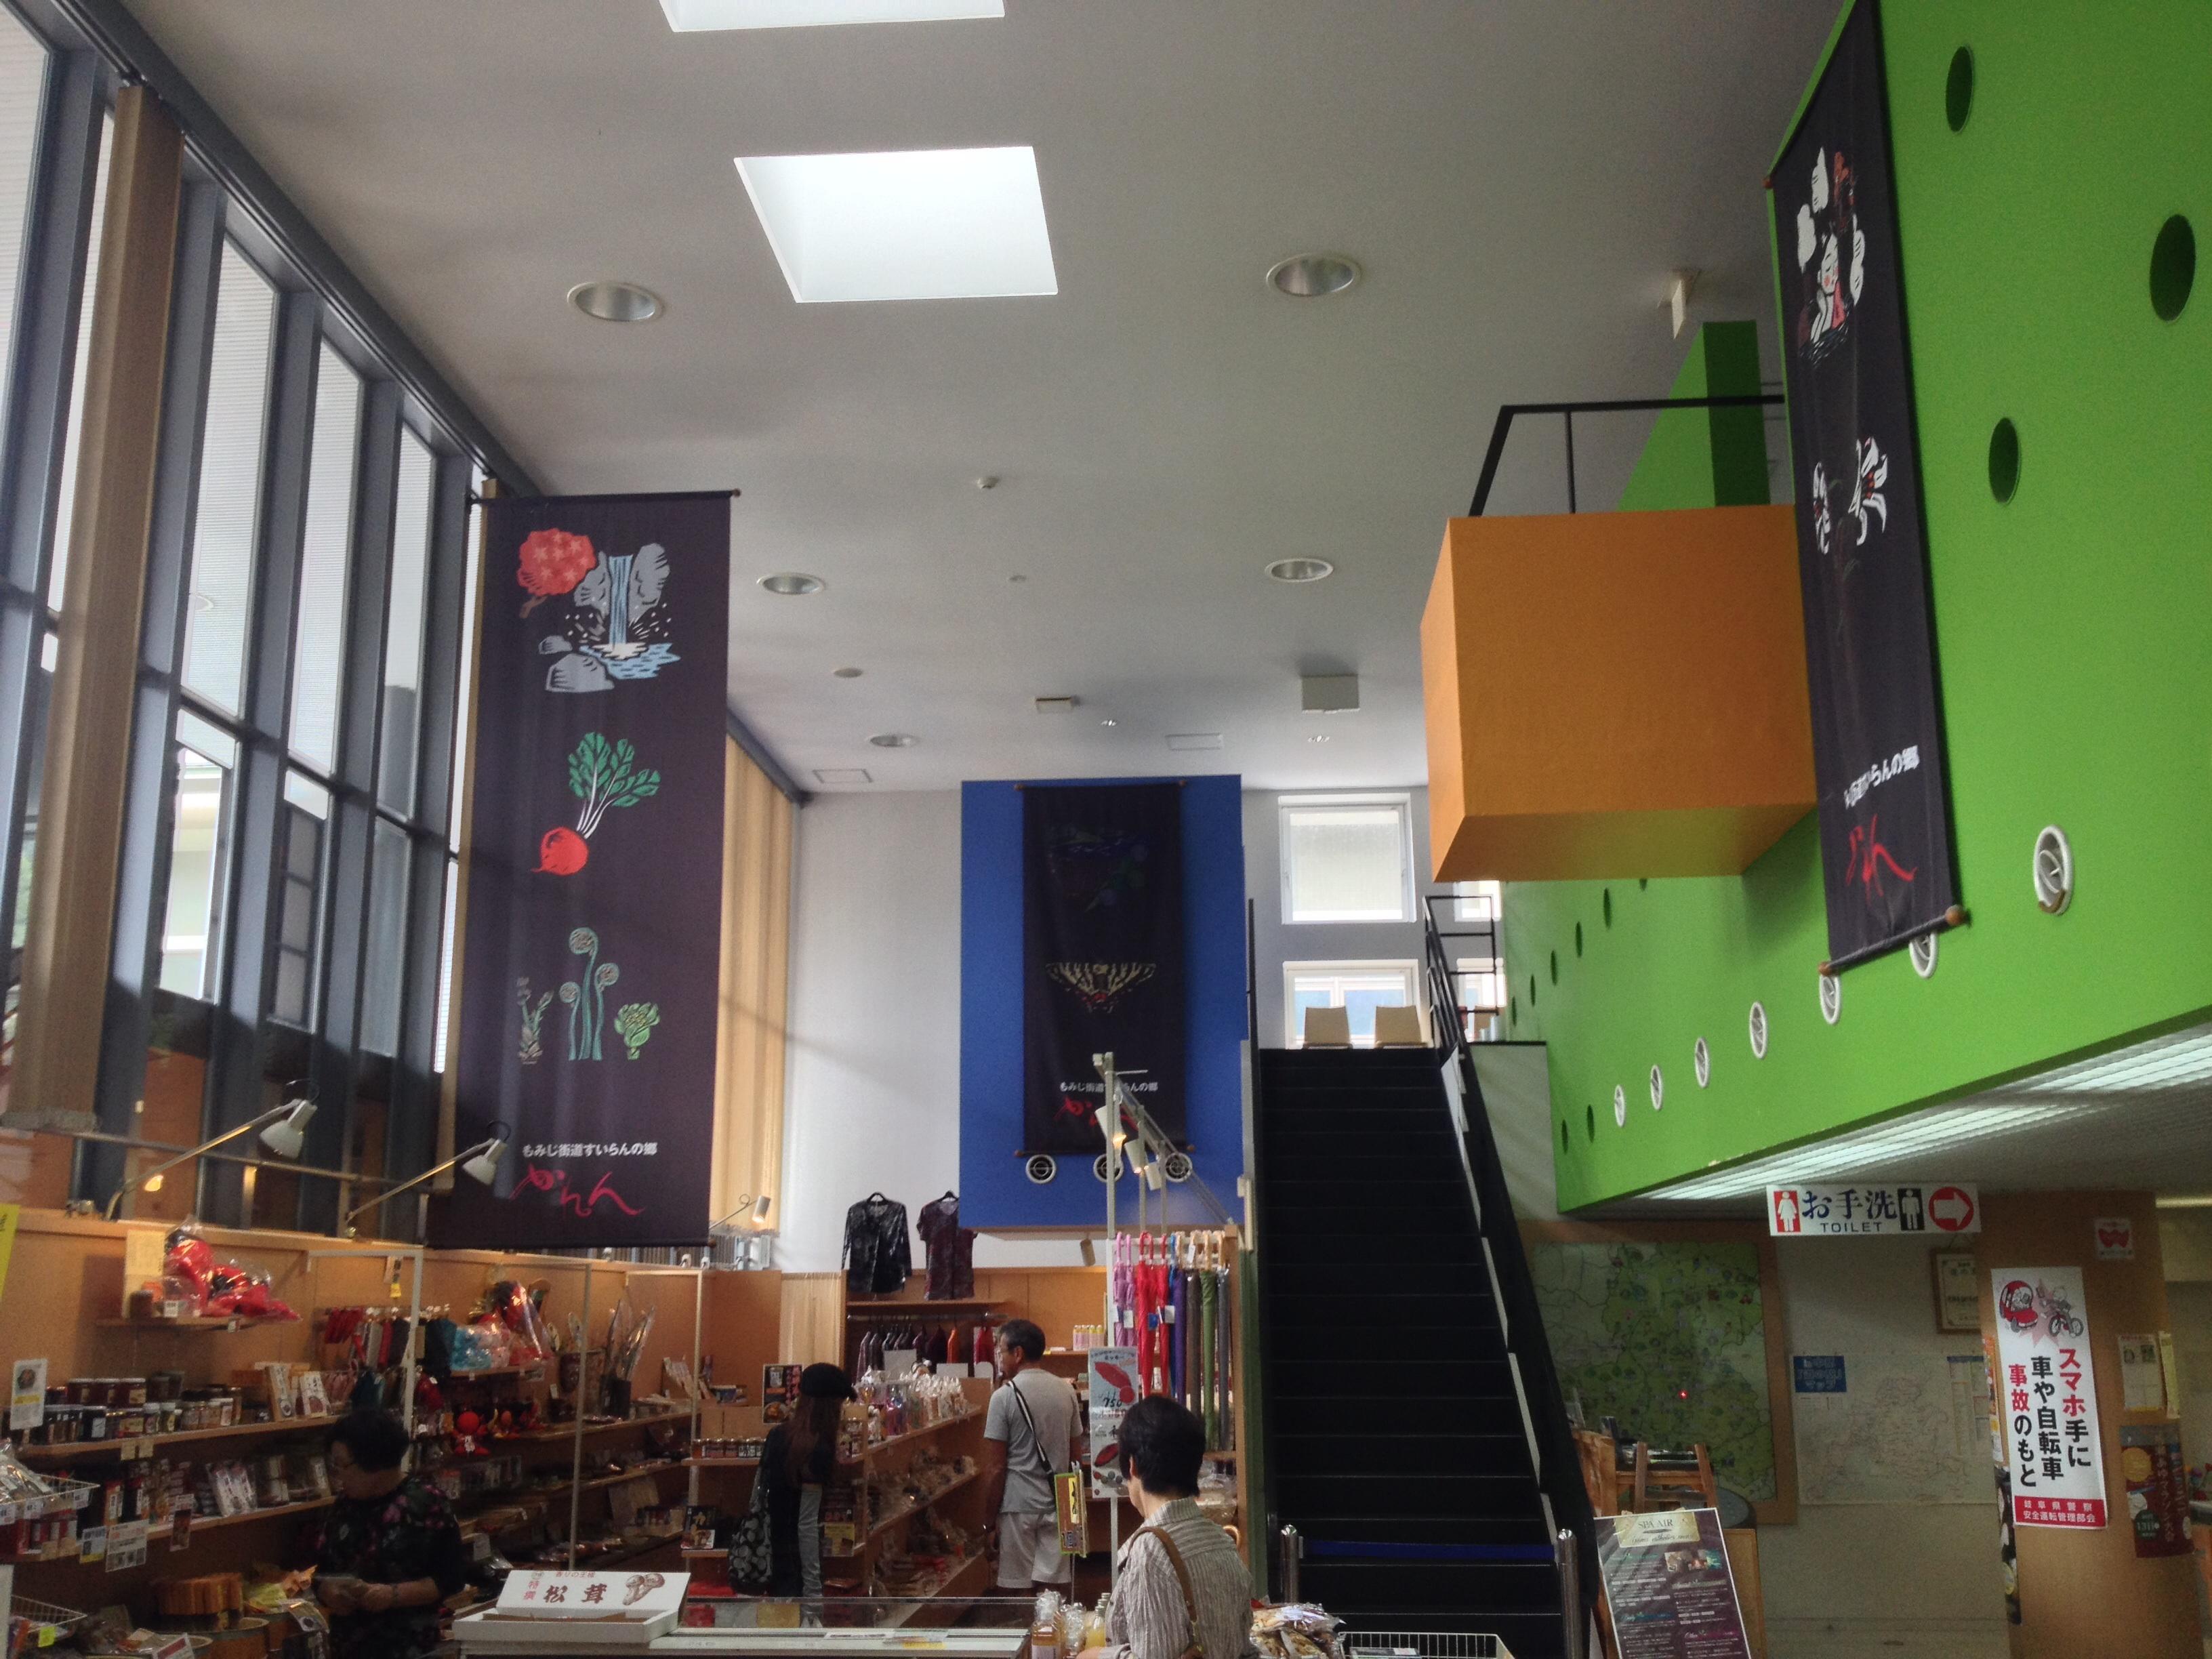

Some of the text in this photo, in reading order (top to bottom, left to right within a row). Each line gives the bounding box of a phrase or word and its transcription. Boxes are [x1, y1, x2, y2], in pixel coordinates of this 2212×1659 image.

[523, 1142, 658, 1158] もみじ街道すいらんの郷
[1802, 1189, 1898, 1220] お手洗
[1820, 1221, 1883, 1233] TOILET
[2031, 1355, 2064, 1481] 車や自転車
[2059, 1349, 2091, 1467] スマホ手に
[2008, 1364, 2036, 1488] 事故のもと
[2024, 1500, 2093, 1513] 岐阜県警察
[1638, 1519, 1674, 1529] SPA AIR
[543, 1583, 608, 1604] 松茸
